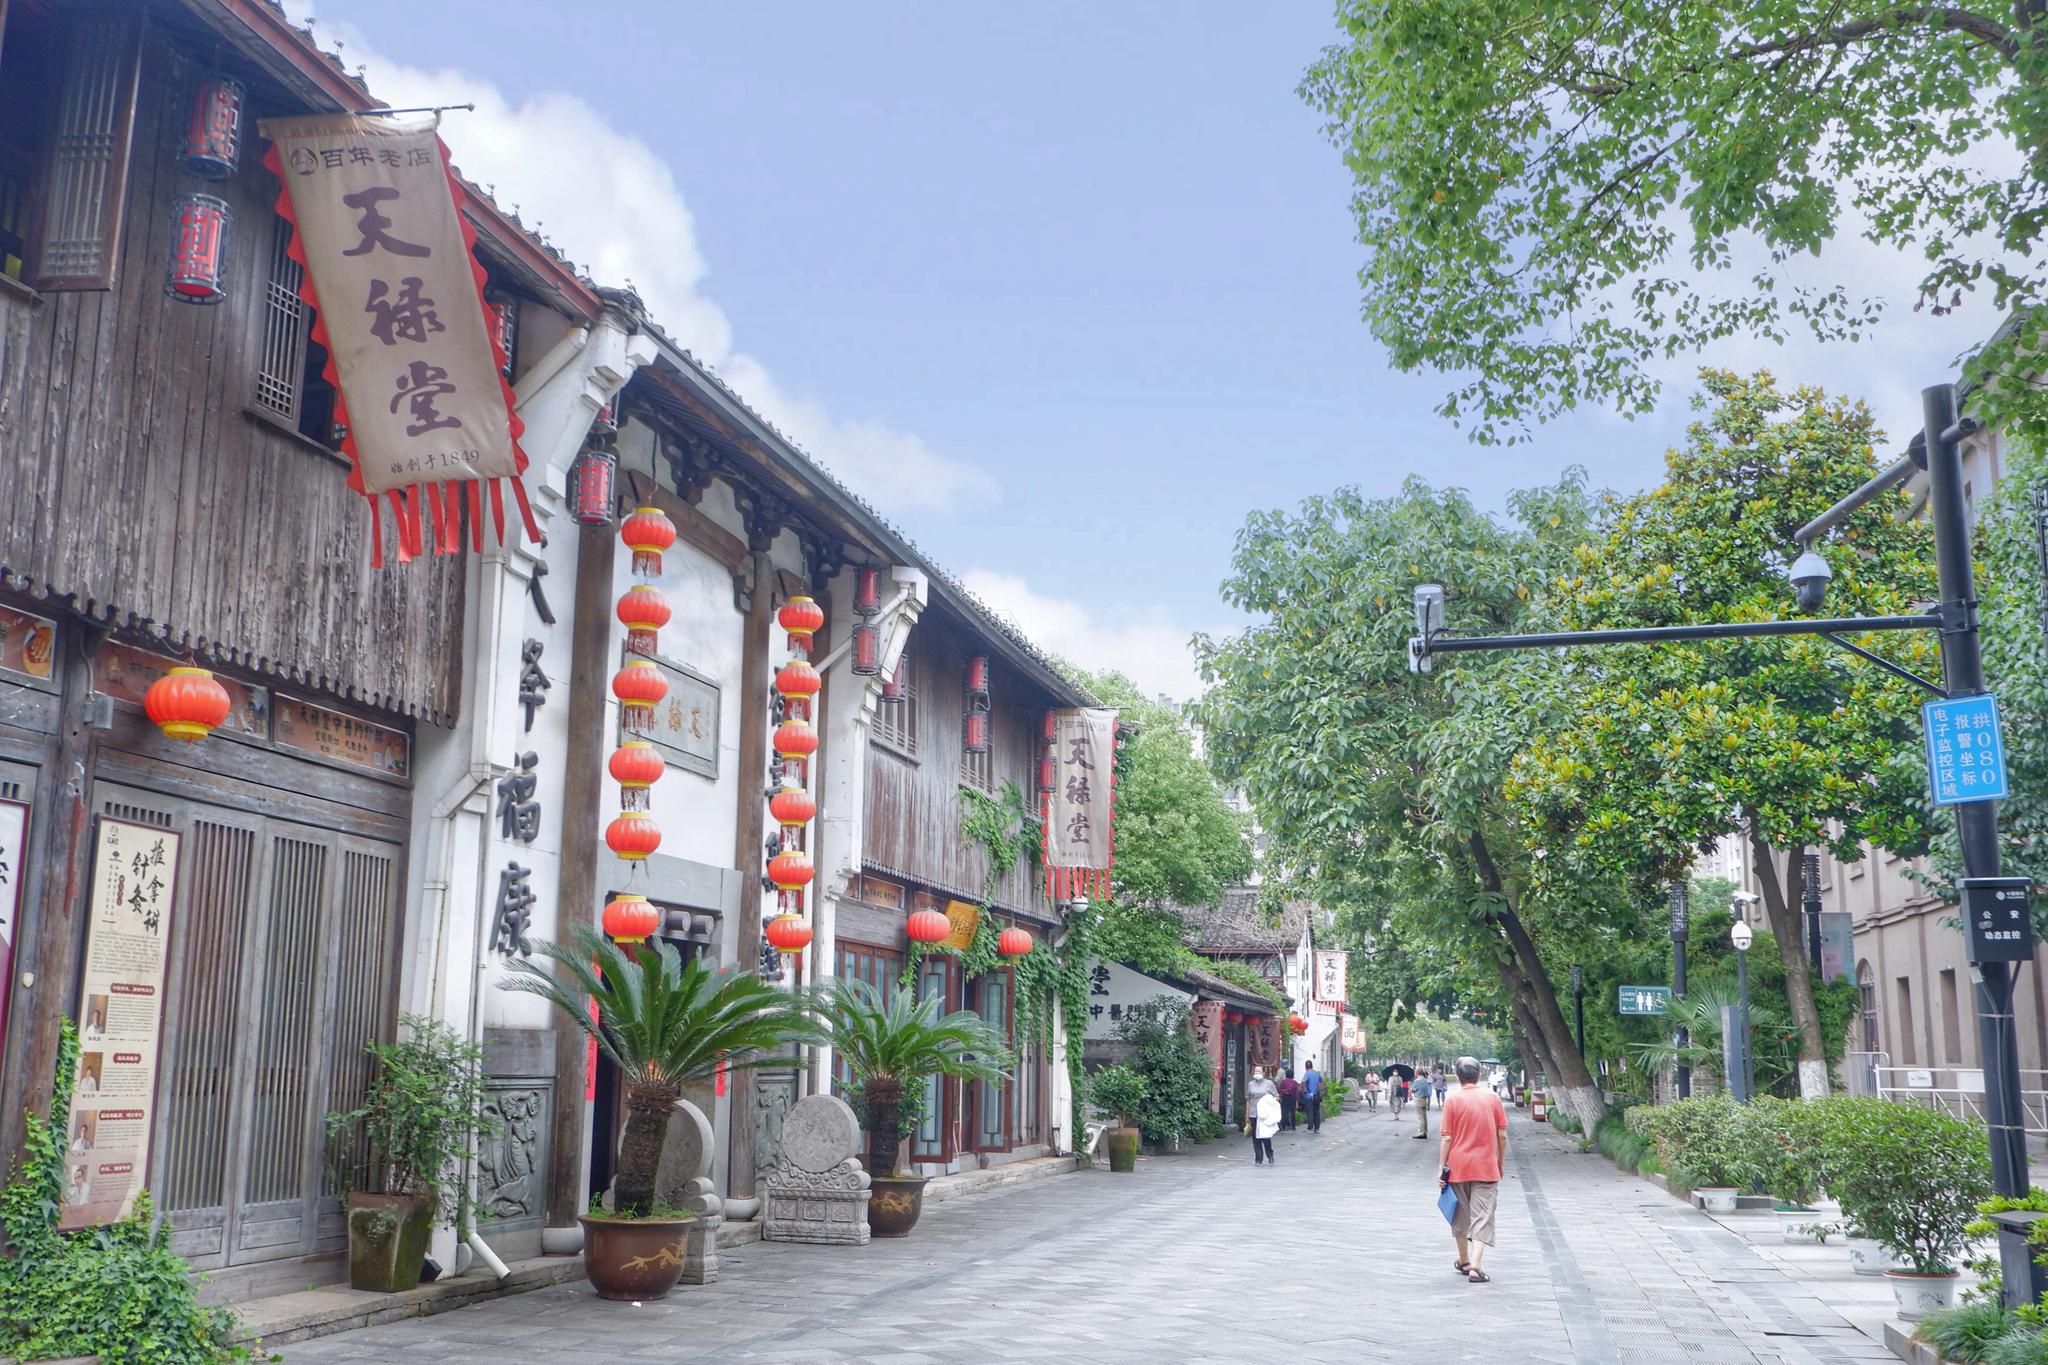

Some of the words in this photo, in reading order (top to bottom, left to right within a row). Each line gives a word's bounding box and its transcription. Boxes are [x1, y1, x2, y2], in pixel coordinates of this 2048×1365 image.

[320, 148, 432, 169] 百年老店
[343, 187, 462, 437] 天禄堂
[1934, 709, 1958, 797] 电子监控区域
[1955, 714, 1977, 786] 报警坐标
[1973, 712, 1995, 785] 拱080
[1064, 737, 1095, 844] 天禄堂
[1984, 930, 2021, 940] 动态监控
